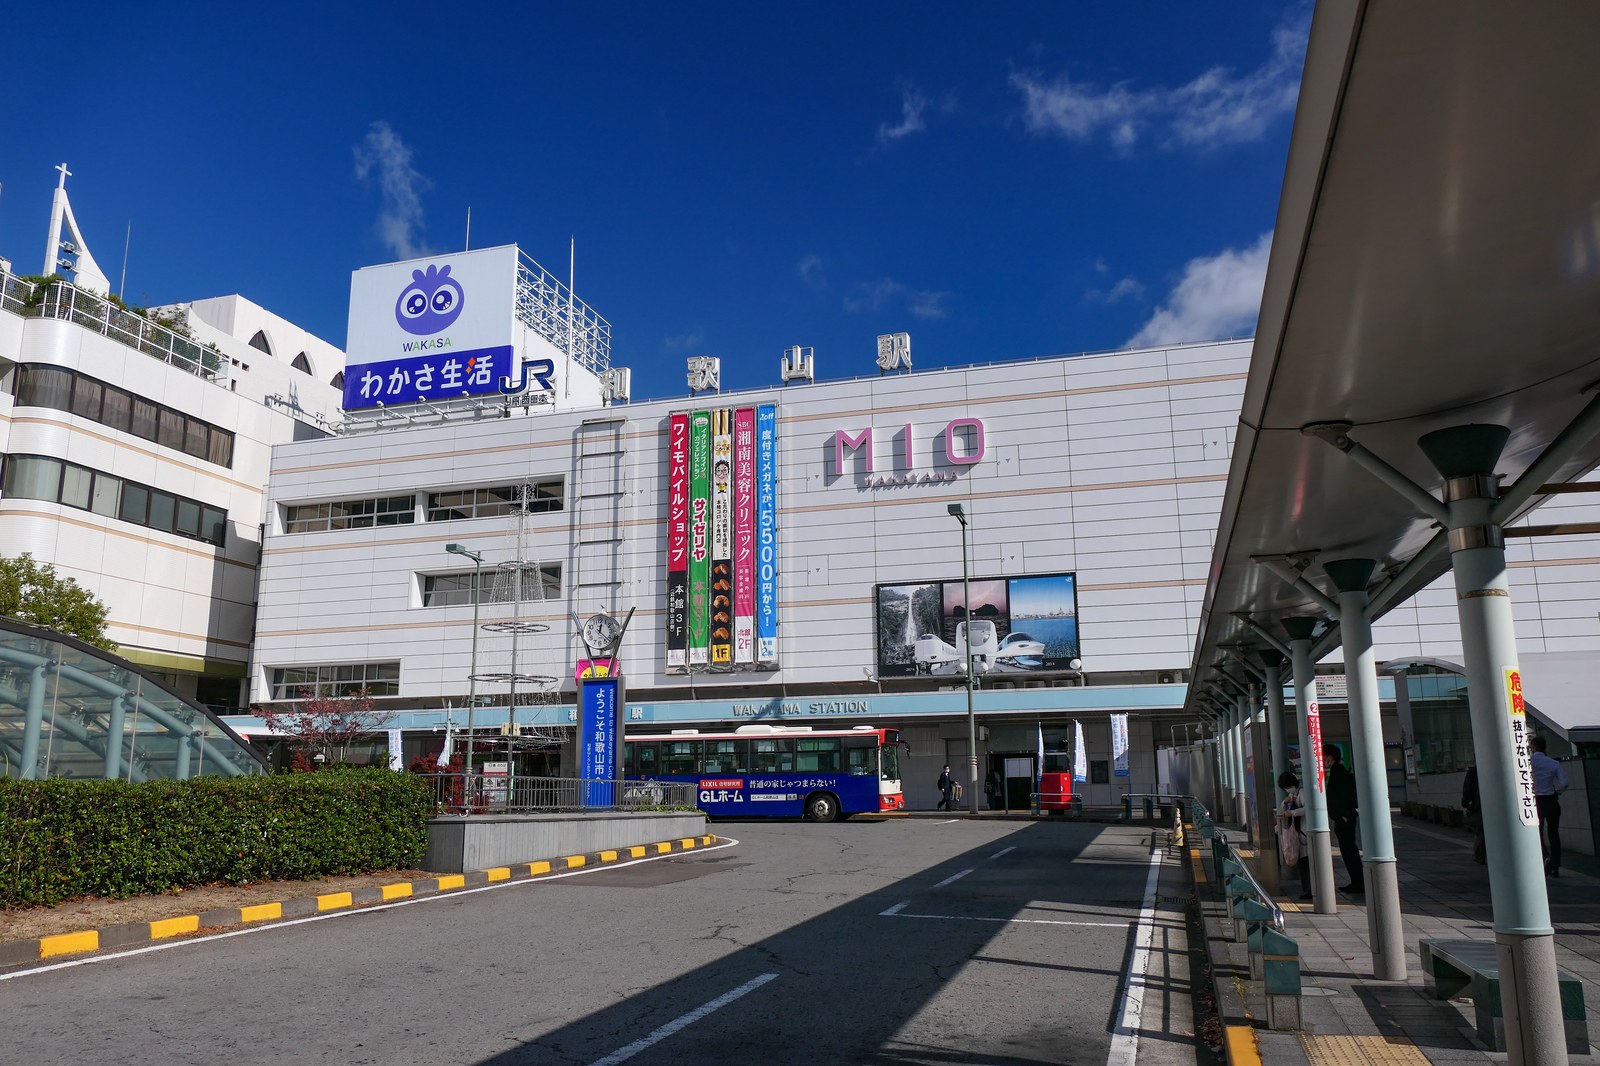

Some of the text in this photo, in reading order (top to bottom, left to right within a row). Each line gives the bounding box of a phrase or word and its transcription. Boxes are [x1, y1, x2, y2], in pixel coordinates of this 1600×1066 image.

[403, 338, 452, 352] WAKASA
[360, 354, 494, 398] わかさ生活
[499, 358, 555, 395] JR
[760, 412, 774, 421] Zoff
[836, 417, 985, 475] MIO
[672, 423, 685, 562] ワイモバイルショップ
[738, 431, 751, 562] 湘南美容クリニック
[864, 470, 958, 488] WAKAYAMA
[692, 498, 706, 562] サイゼリヤ
[675, 584, 685, 637] 本館3F
[715, 648, 728, 658] 1F
[738, 638, 751, 649] 2F
[733, 700, 868, 716] WAKAYAMA STATION
[1510, 671, 1525, 714] 危険
[1512, 719, 1534, 820] 抜けないで下さい
[700, 790, 744, 803] GLホーム
